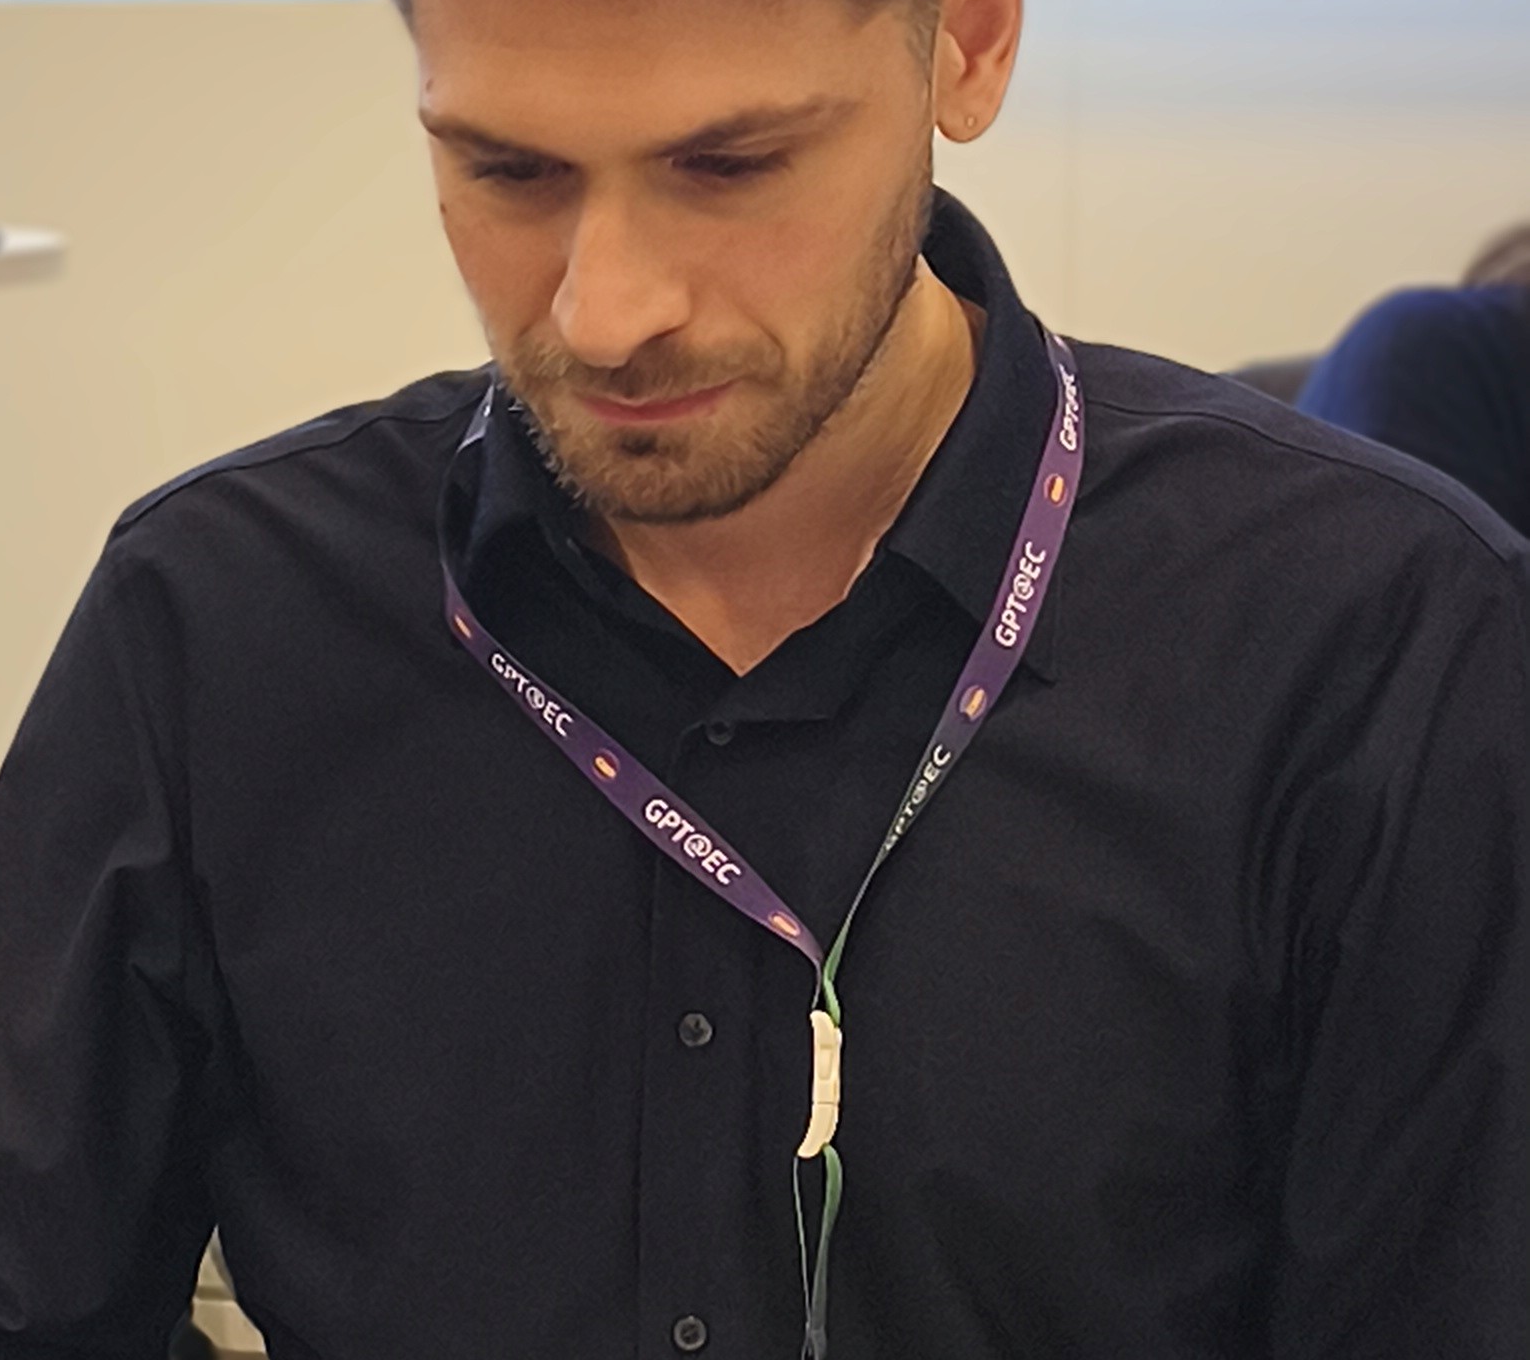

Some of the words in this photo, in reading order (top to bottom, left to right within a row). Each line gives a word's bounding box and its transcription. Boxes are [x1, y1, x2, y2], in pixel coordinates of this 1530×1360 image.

[995, 542, 1046, 648] GPT@EC
[491, 652, 574, 737] GPT@EC
[644, 798, 742, 886] GPT@EC
